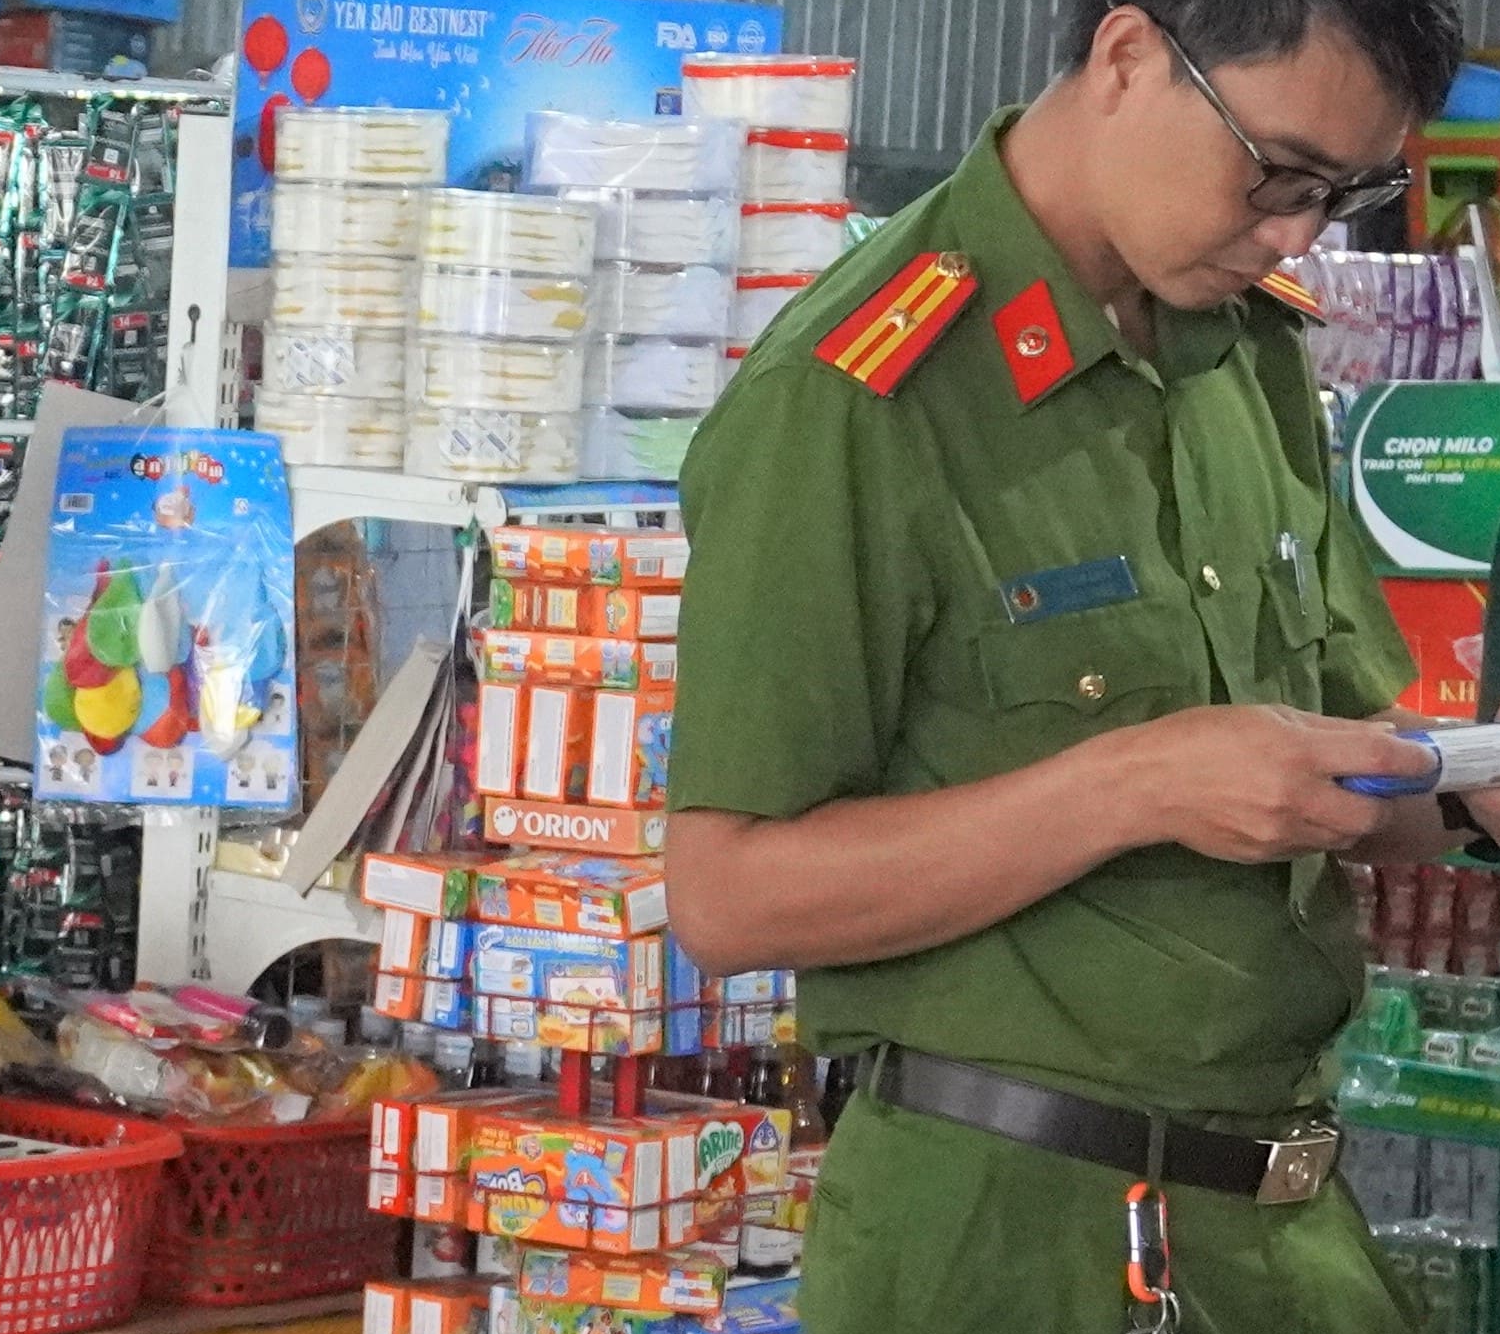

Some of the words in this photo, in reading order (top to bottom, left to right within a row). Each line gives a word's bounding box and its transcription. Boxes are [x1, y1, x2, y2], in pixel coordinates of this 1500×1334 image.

[408, 5, 489, 38] BESTNEST
[657, 21, 698, 50] FDA
[1385, 435, 1441, 457] CHỌN
[1444, 435, 1494, 454] MILO
[523, 811, 609, 842] ORION
